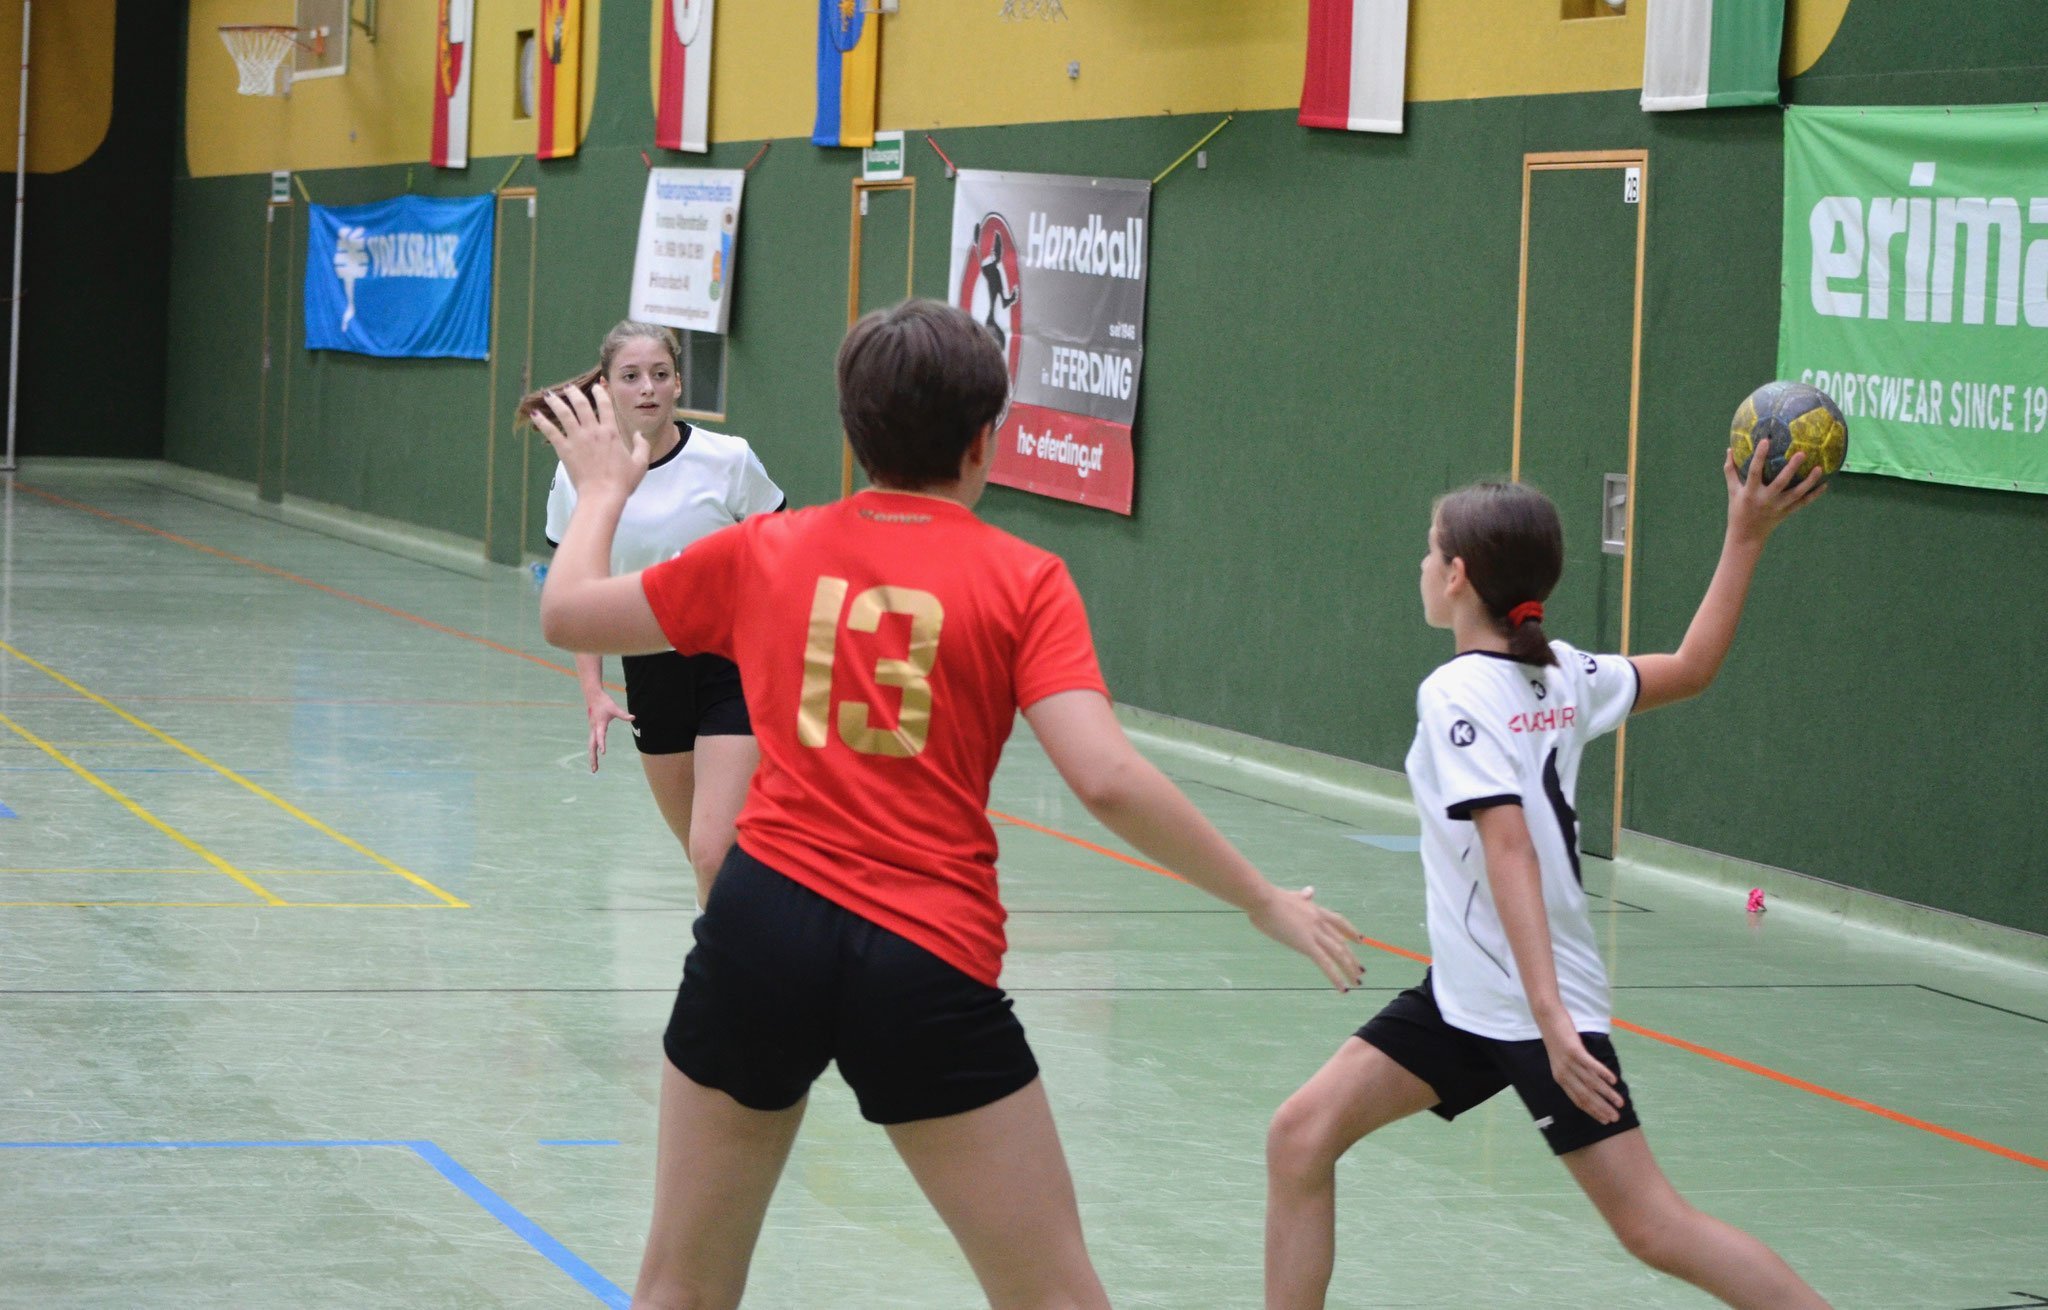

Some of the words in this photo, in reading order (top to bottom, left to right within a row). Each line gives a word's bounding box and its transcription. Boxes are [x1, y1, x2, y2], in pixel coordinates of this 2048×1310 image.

[367, 232, 460, 279] VOLKSBANK
[1026, 212, 1143, 280] Handball
[1050, 346, 1132, 400] EFERDING
[1950, 381, 2015, 432] SINCE
[2023, 386, 2048, 433] 19
[797, 575, 945, 758] 13
[1452, 721, 1473, 746] K
